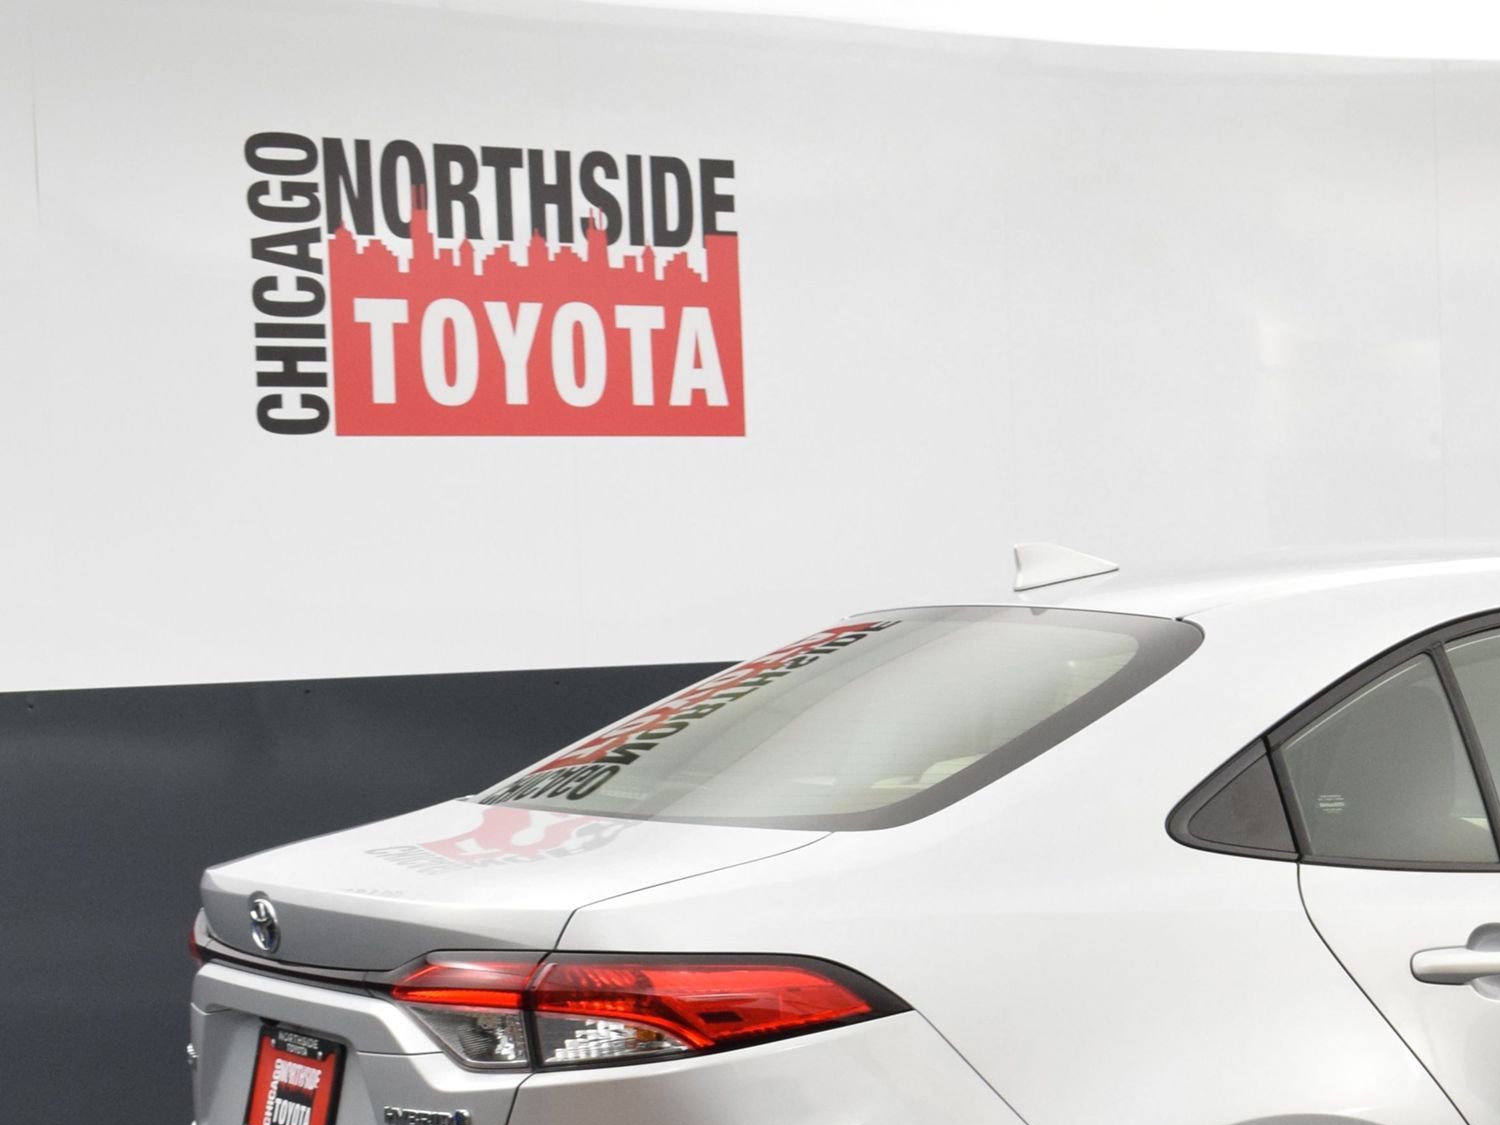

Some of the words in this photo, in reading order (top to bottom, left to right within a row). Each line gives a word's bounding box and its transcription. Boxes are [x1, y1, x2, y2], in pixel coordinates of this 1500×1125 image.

[321, 137, 738, 249] NORTHSIDE
[244, 131, 330, 436] CHICAGO
[353, 298, 730, 408] TOYOTA
[278, 1030, 319, 1050] NORTHSIDE
